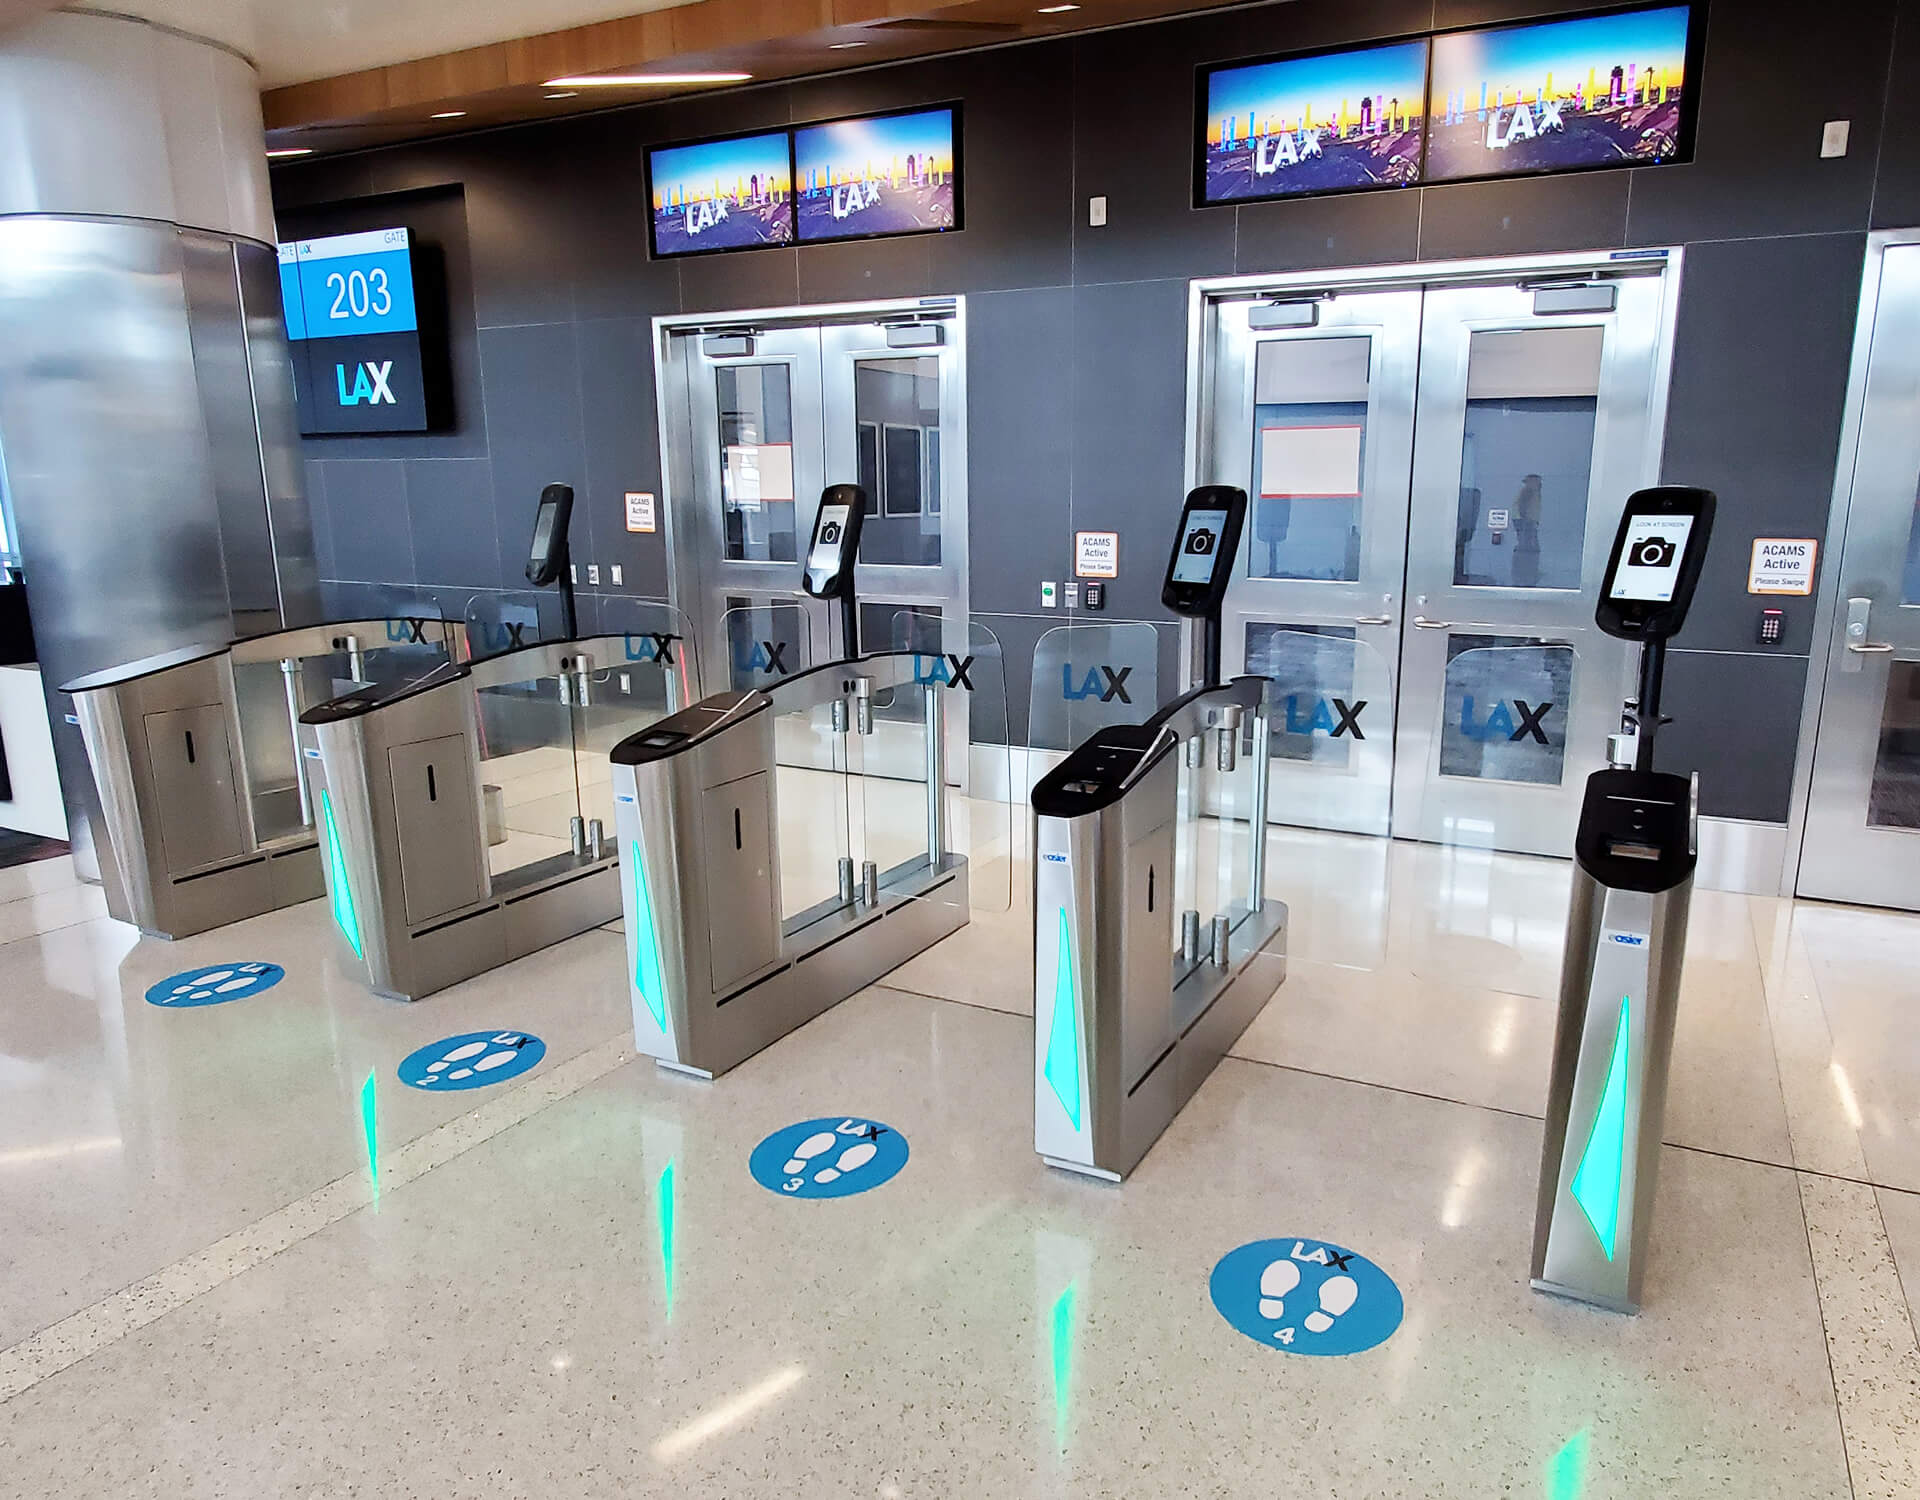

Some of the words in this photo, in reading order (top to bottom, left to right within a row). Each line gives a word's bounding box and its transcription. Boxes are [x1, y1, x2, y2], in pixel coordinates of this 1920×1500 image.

[1485, 100, 1566, 149] LAX
[1255, 128, 1324, 175] LAX
[832, 181, 880, 218] LAX
[685, 199, 730, 235] LAX
[384, 230, 405, 244] GATE
[326, 268, 392, 319] 203
[336, 361, 396, 406] LAX
[1083, 537, 1110, 546] ACAMS
[1084, 548, 1108, 557] Active
[1762, 545, 1805, 556] ACAMS
[1763, 559, 1800, 569] Active
[1755, 577, 1780, 585] Please
[1781, 578, 1805, 587] Swipe
[386, 617, 427, 645] LAX
[625, 632, 675, 664] LAX
[735, 641, 788, 674] LAX
[914, 653, 974, 690] LAX
[1063, 662, 1132, 704] LAX
[1285, 694, 1368, 740] LAX
[1460, 695, 1555, 744] LAX
[416, 1075, 439, 1086] 2
[836, 1119, 888, 1141] LAX
[783, 1177, 804, 1192] 3
[1290, 1241, 1355, 1272] LAX
[1273, 1327, 1295, 1345] 4
